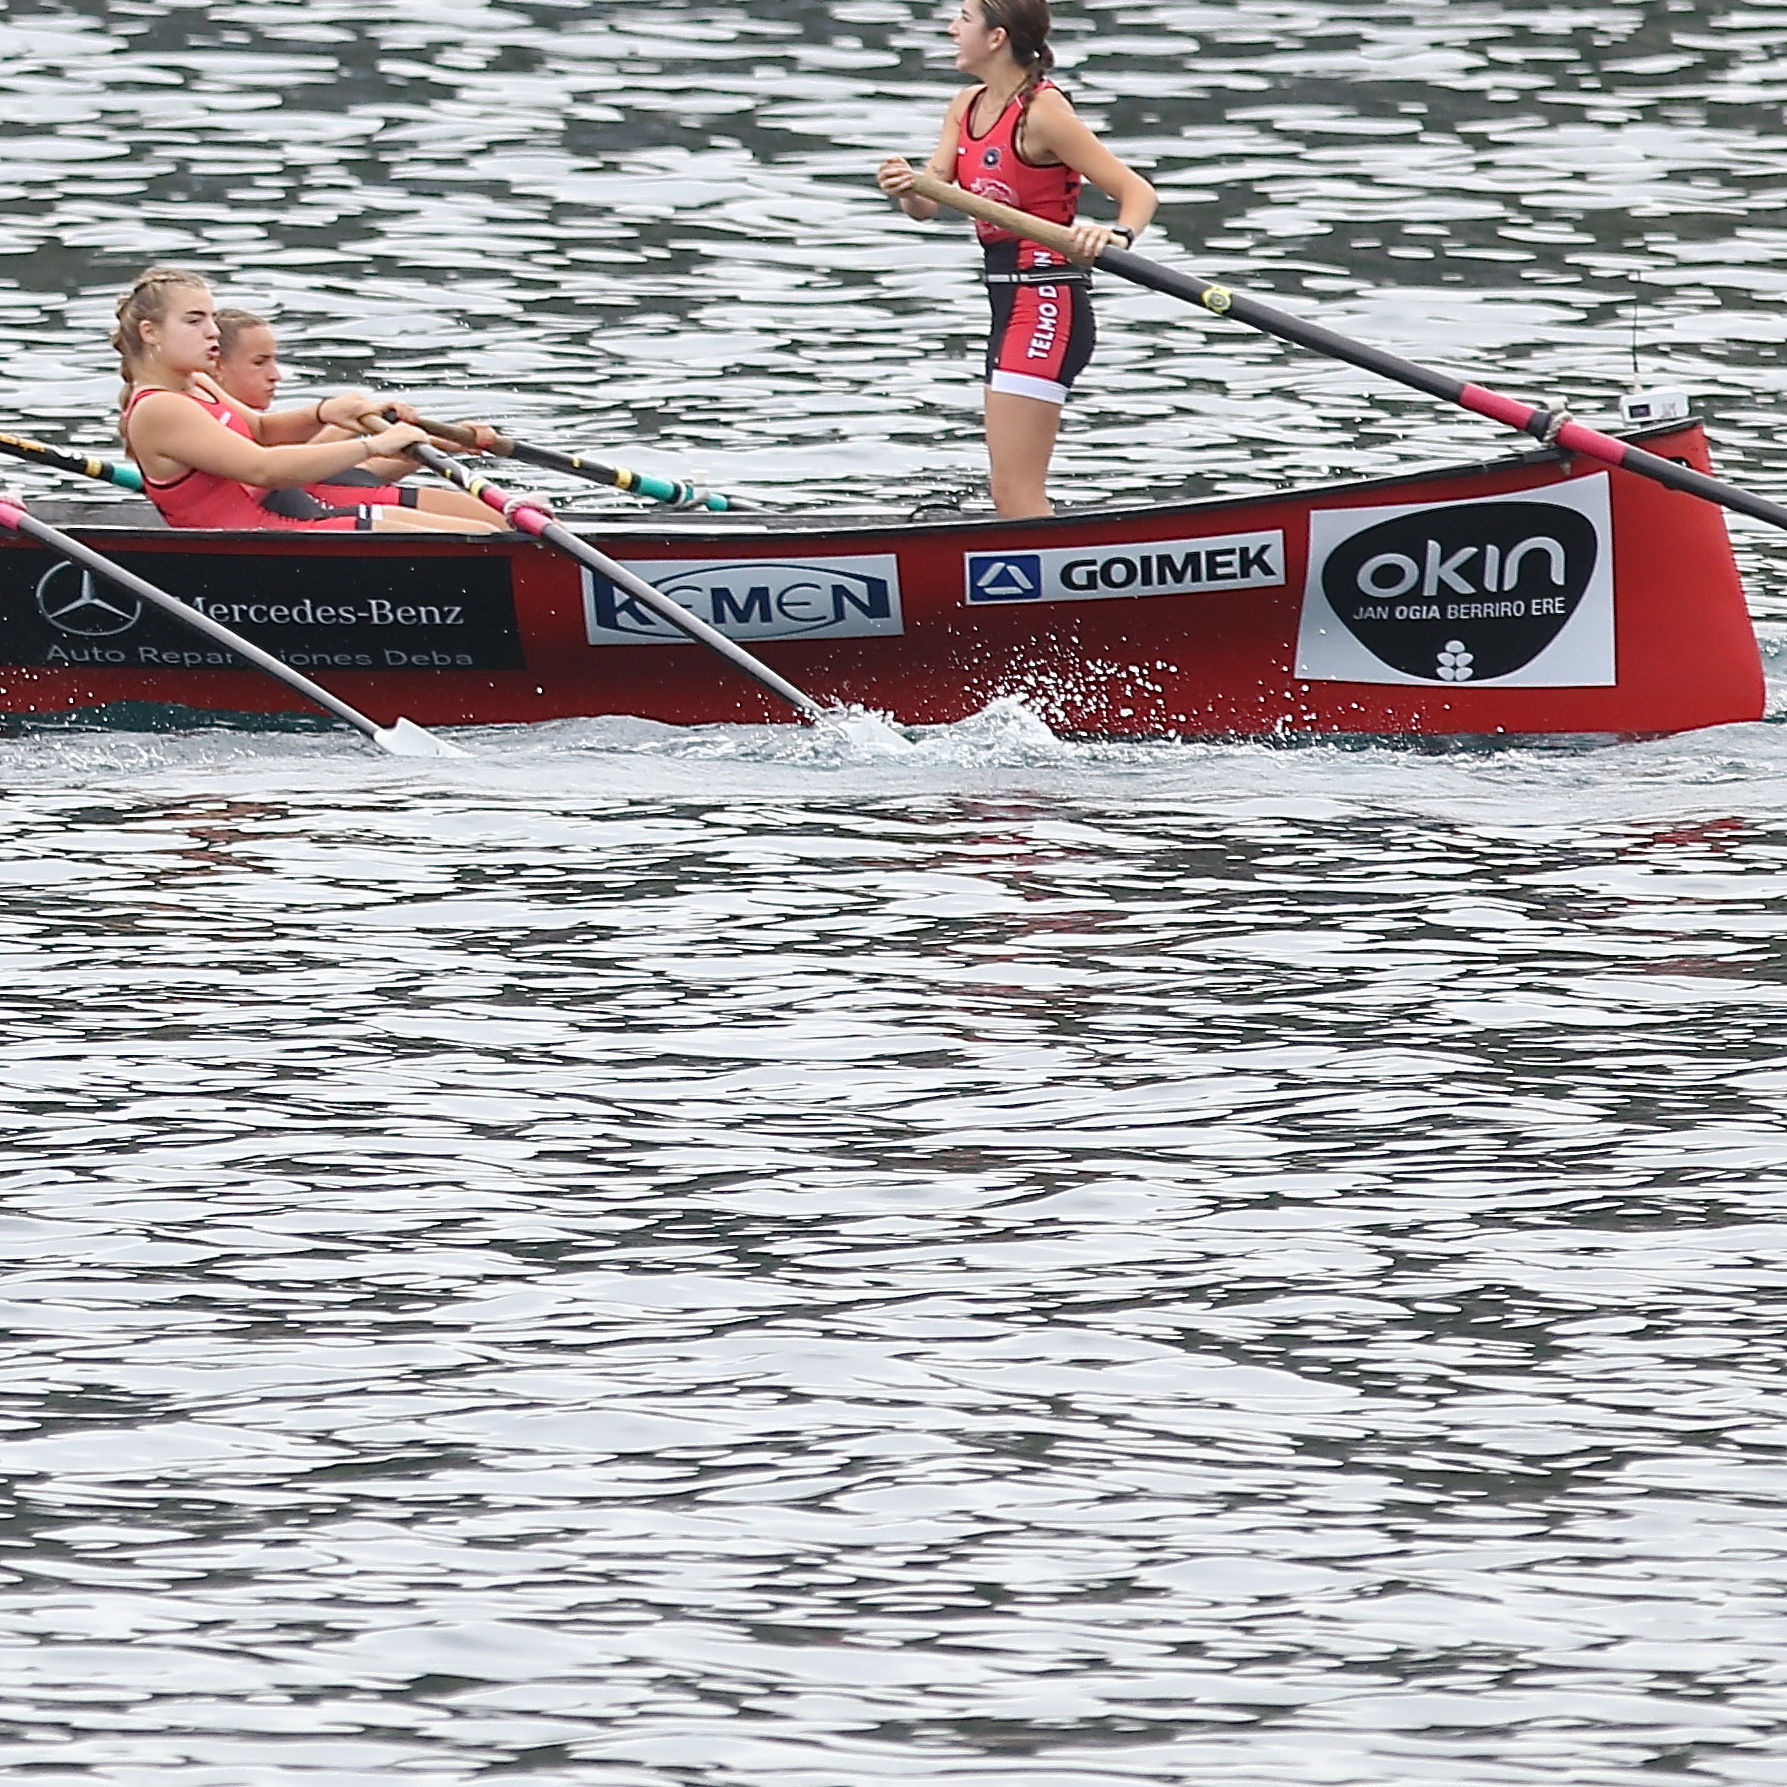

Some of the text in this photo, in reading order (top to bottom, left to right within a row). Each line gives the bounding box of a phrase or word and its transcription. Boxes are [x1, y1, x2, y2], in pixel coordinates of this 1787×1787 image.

[1027, 300, 1059, 360] TELMO
[1059, 543, 1273, 591] GOIMEK
[1353, 597, 1566, 620] JAN OGIA BERRIRO ERE
[46, 644, 126, 663] Auto
[383, 649, 474, 667] Deba
